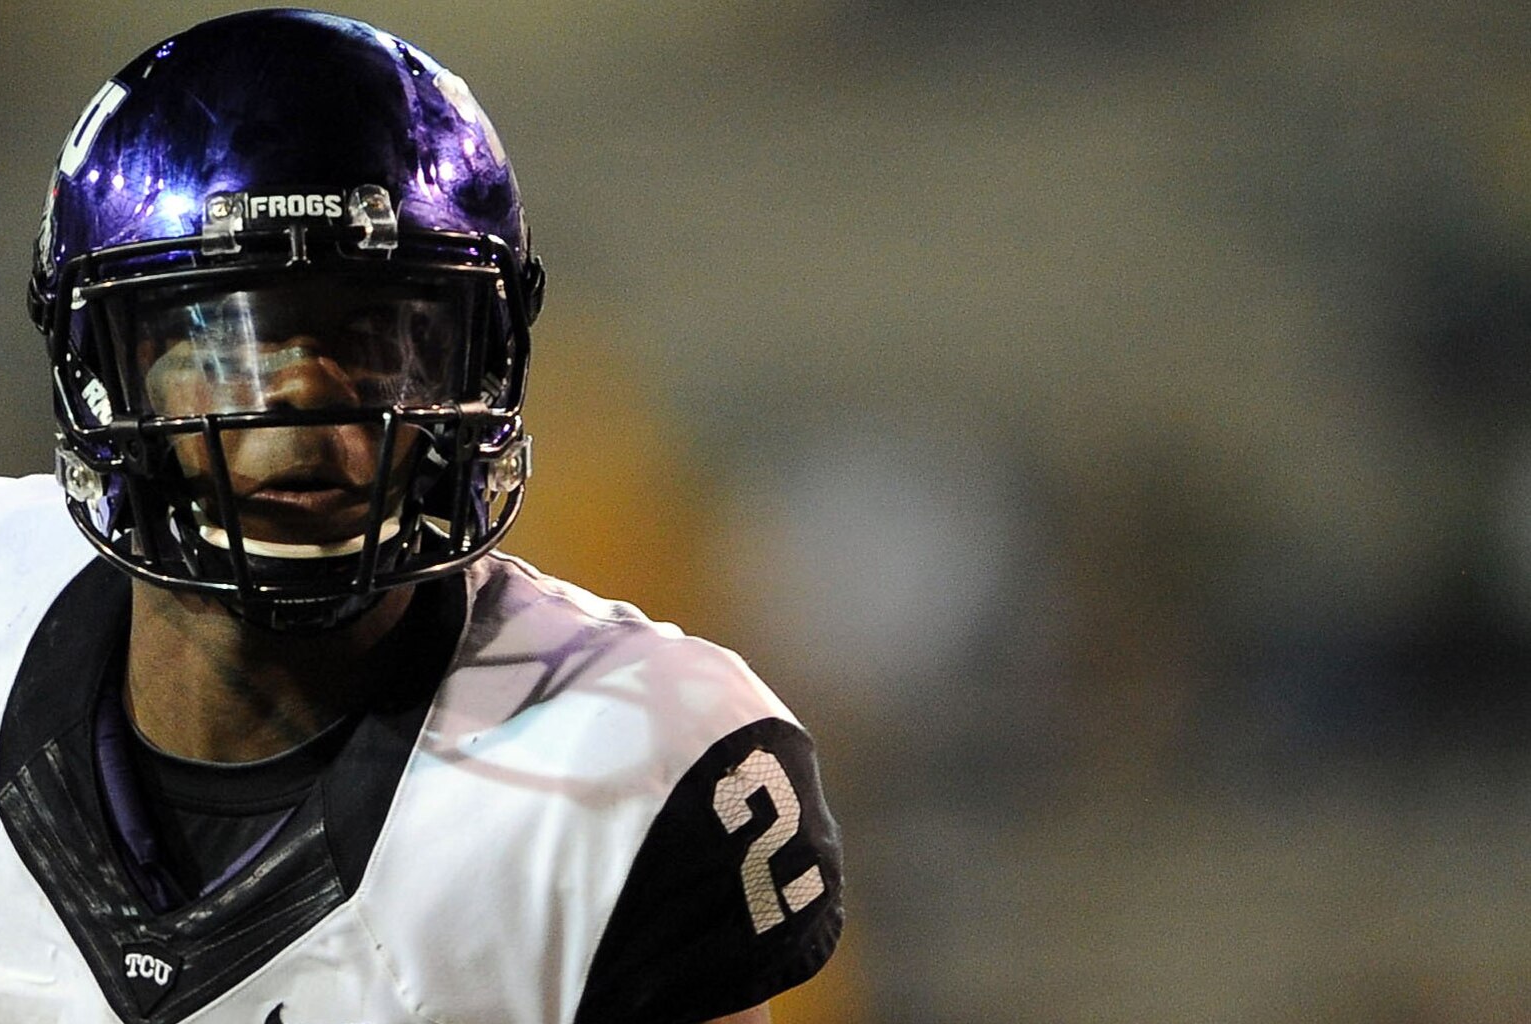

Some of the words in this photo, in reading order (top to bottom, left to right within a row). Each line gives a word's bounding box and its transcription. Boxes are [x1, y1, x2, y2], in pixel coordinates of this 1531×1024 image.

[250, 194, 343, 219] FROGS
[712, 748, 826, 936] 2
[124, 952, 173, 986] TCU
